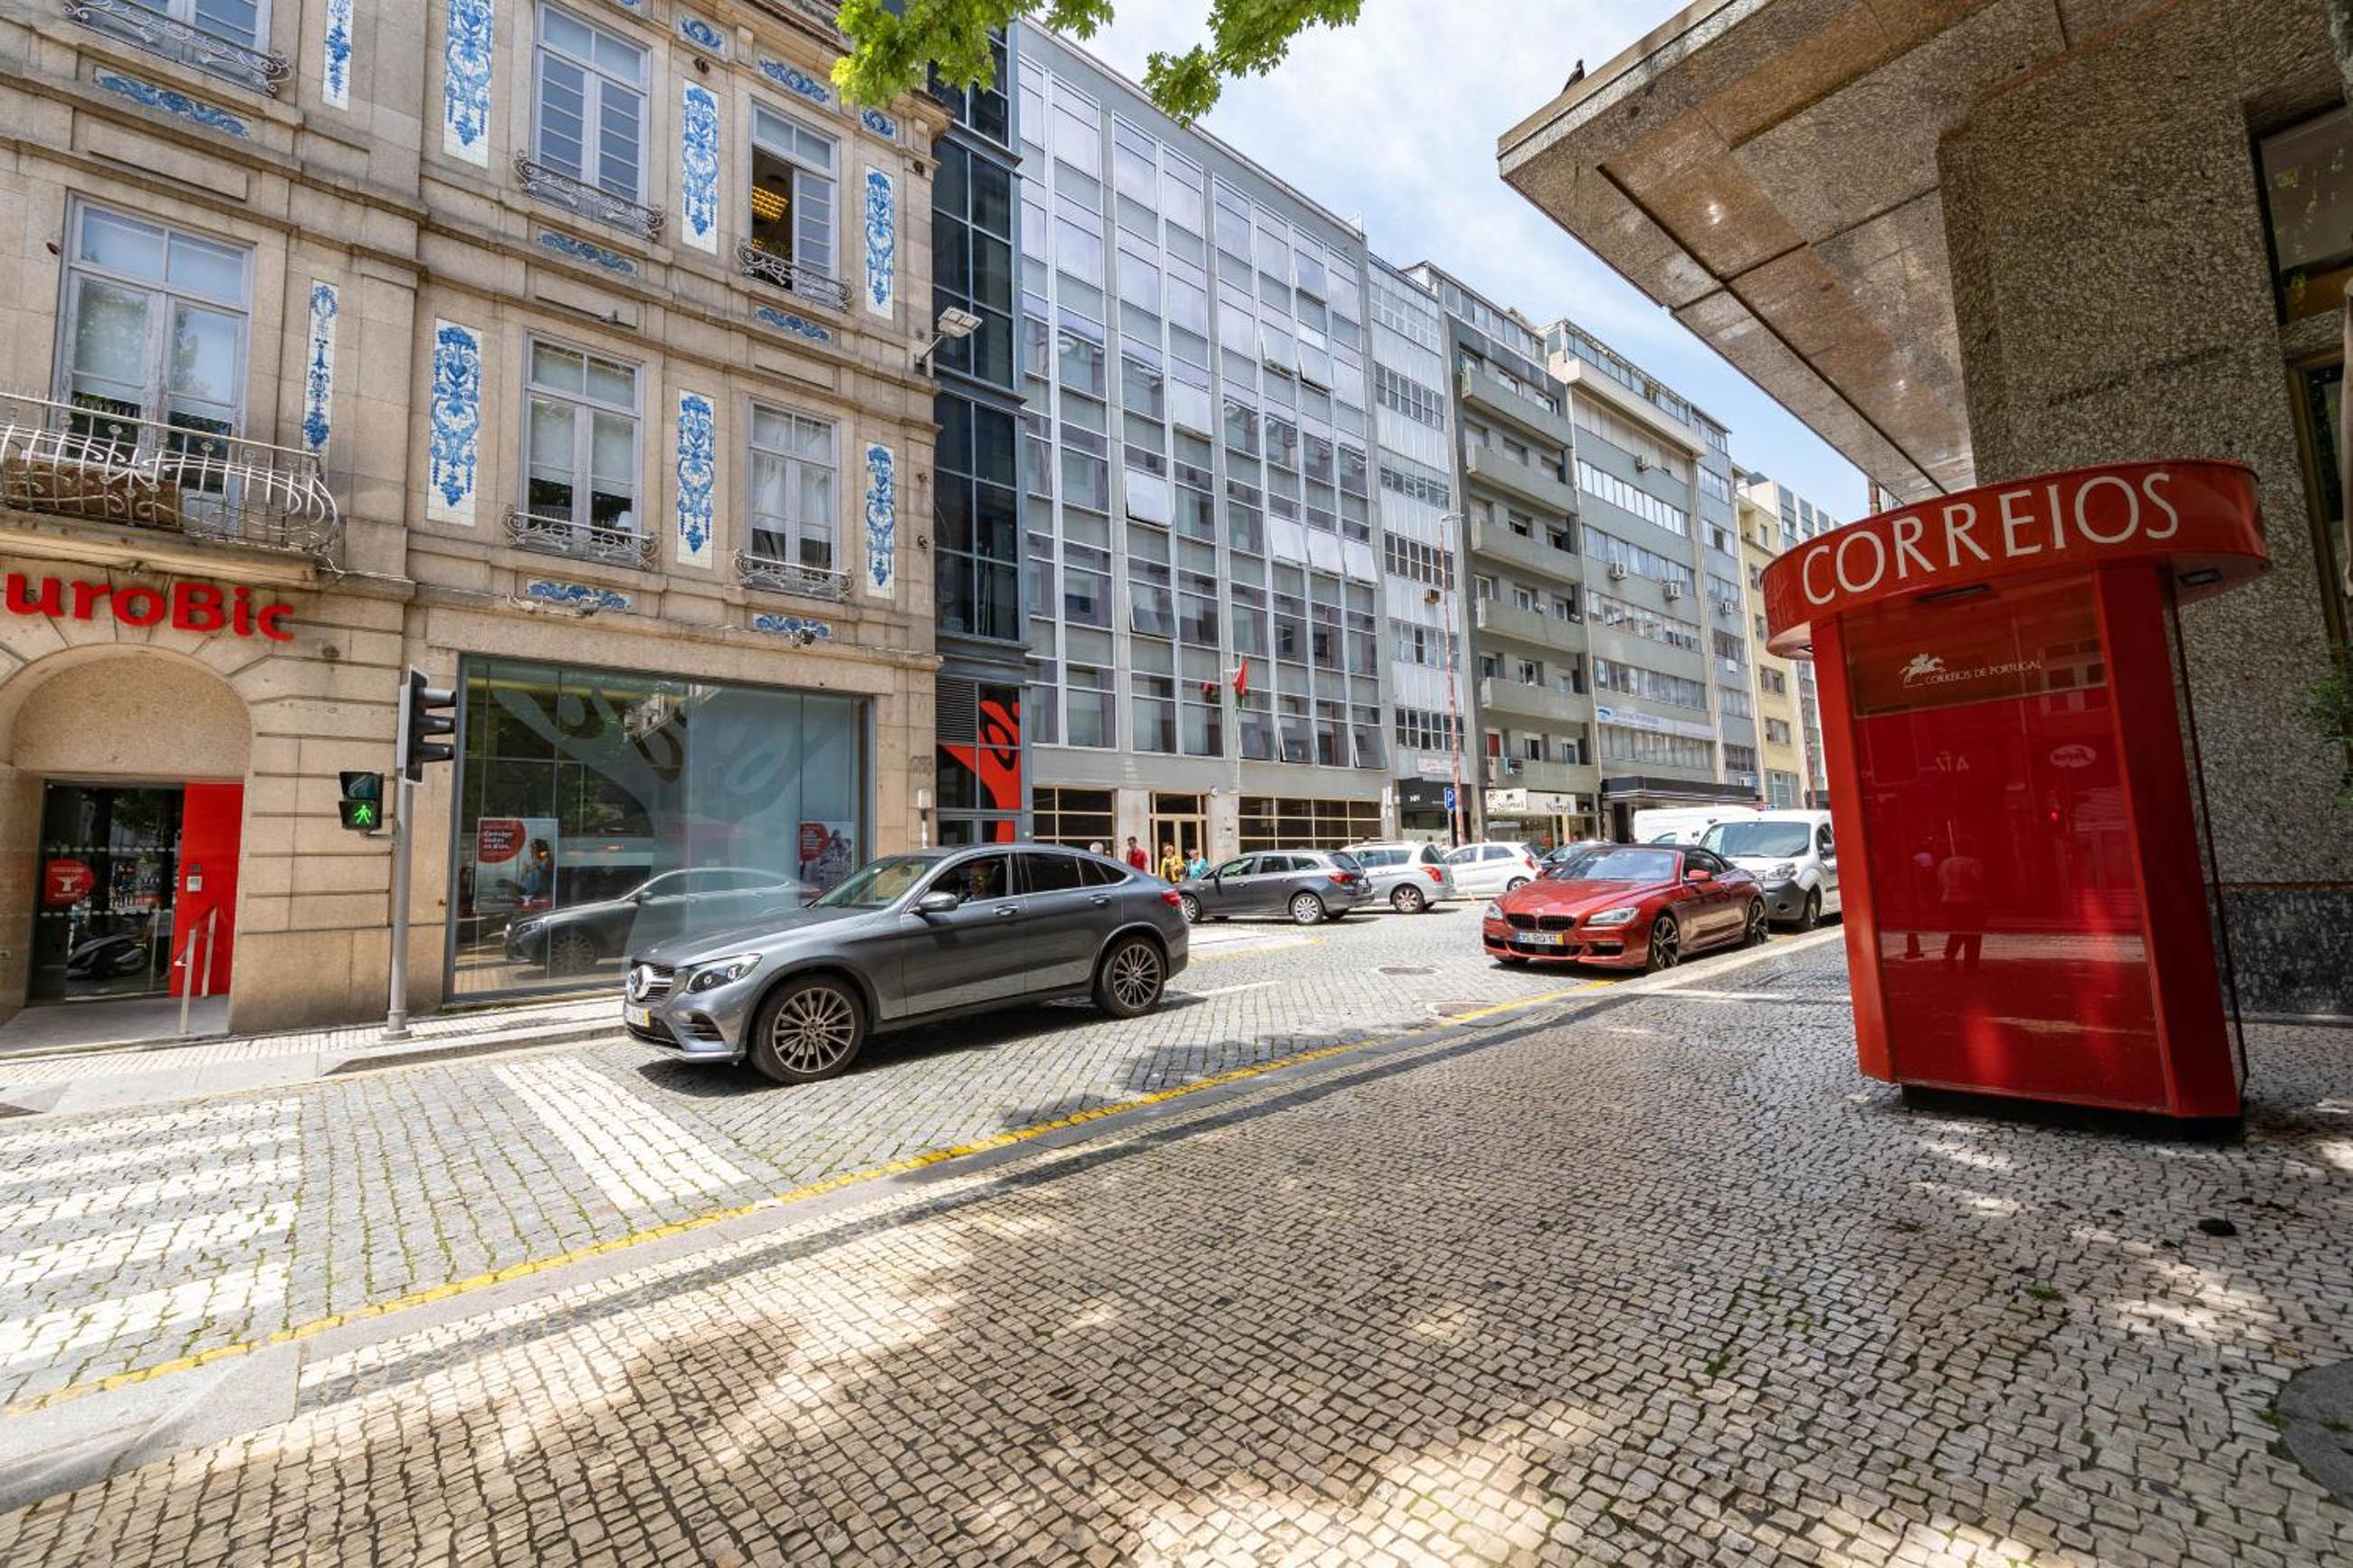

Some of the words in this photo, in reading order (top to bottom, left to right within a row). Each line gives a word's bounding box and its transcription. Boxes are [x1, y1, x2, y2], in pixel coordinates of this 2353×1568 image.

[1802, 471, 2178, 605] CORREIOS
[0, 572, 295, 641] uroBic
[1926, 669, 1973, 685] CORREIOS
[1974, 666, 1987, 678] DE
[1988, 659, 2043, 676] PORTUGAL
[1448, 790, 1453, 801] P
